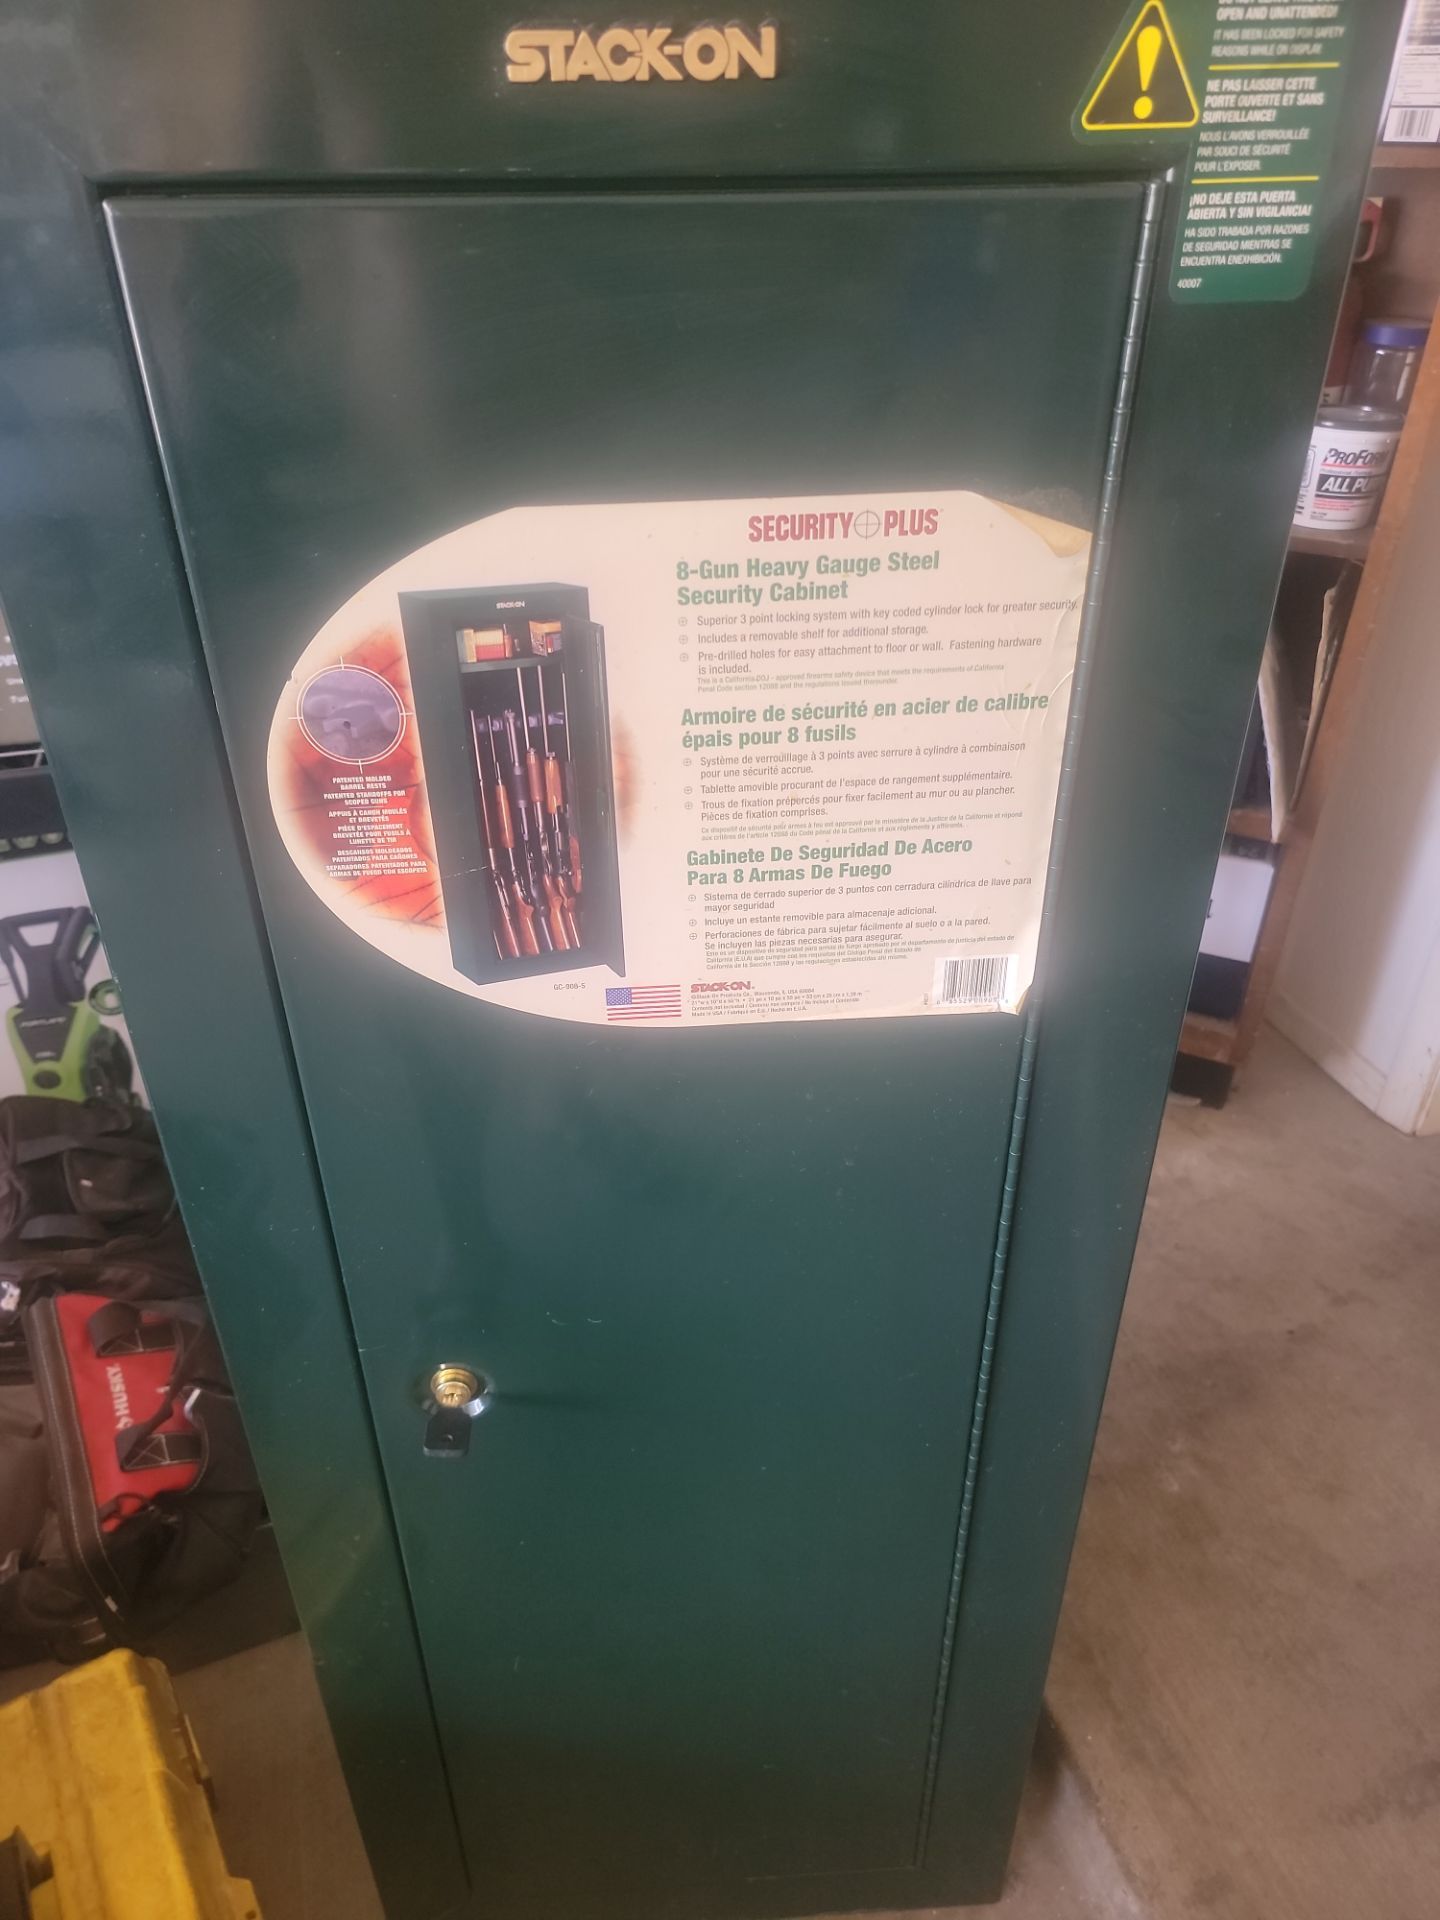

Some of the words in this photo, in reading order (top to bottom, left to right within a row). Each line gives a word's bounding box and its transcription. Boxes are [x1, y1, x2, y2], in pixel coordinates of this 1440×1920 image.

[1216, 7, 1245, 21] OPEN
[1245, 6, 1268, 20] AND
[505, 26, 776, 82] STACK-ON
[1207, 79, 1220, 92] NE
[1222, 78, 1241, 91] PAS
[1243, 78, 1284, 91] LAISSER
[1285, 76, 1317, 90] CETTE
[1204, 95, 1236, 108] PORTE
[1238, 94, 1281, 107] OUVERTE
[1282, 93, 1296, 106] ET
[1296, 92, 1324, 105] SANS
[1202, 109, 1276, 123] SURVEILLANCE!
[1208, 192, 1233, 205] DEJE
[1234, 191, 1257, 204] ESTA
[1260, 190, 1296, 203] PUERTA
[1187, 207, 1226, 220] ABIERTA
[1230, 207, 1236, 218] Y
[1237, 206, 1254, 218] SIN
[1256, 204, 1312, 217] VIGILANCIA!
[1184, 227, 1195, 237] HA
[1197, 227, 1216, 237] SIDO
[1218, 225, 1253, 236] TRABADA
[1255, 225, 1271, 235] POR
[1273, 224, 1310, 234] RAZONES
[1182, 242, 1193, 252] DE
[1195, 241, 1239, 252] SEGURIDAD
[1240, 239, 1280, 250] MIENTRAS
[1281, 239, 1292, 249] SE
[1181, 255, 1225, 266] ENCUENTRA
[1177, 278, 1202, 288] 40007
[1321, 477, 1350, 493] ALL
[748, 512, 854, 542] SECURITY
[883, 508, 938, 536] PLUS
[676, 558, 740, 581] 8-Gun
[746, 557, 809, 581] Heavy
[816, 554, 881, 577] Gauge
[888, 551, 940, 571] Steel
[677, 584, 762, 608] Security
[769, 580, 849, 603] Cabinet
[697, 615, 737, 627] Superior
[740, 615, 746, 624] 3
[749, 613, 773, 625] point
[776, 612, 810, 624] locking
[813, 611, 847, 622] system
[850, 609, 870, 619] with
[873, 608, 889, 619] key
[893, 607, 921, 617] coded
[924, 605, 961, 618] cylinder
[965, 604, 983, 614] lock
[987, 603, 999, 613] for
[1002, 602, 1036, 614] greater
[1039, 599, 1078, 611] security.
[697, 633, 737, 643] Includes
[740, 634, 746, 642] a
[749, 631, 798, 641] removable
[801, 628, 824, 639] shelf
[827, 628, 839, 638] for
[842, 626, 888, 637] additional
[891, 624, 928, 637] storage.
[698, 650, 748, 662] Pre-drilled
[750, 649, 775, 659] holes
[778, 648, 790, 658] for
[794, 648, 815, 658] easy
[818, 645, 871, 657] attachment
[874, 645, 882, 653] to
[886, 642, 906, 653] floor
[910, 643, 919, 652] or
[922, 641, 944, 651] wall.
[949, 639, 995, 651] Fastening
[998, 636, 1042, 648] hardware
[699, 665, 707, 674] is
[709, 664, 751, 674] included.
[681, 706, 756, 726] Armoire
[763, 705, 785, 722] de
[792, 700, 867, 721] sécurité
[874, 702, 896, 716] en
[903, 697, 950, 715] acier
[956, 696, 978, 713] de
[984, 692, 1049, 711] calibre
[682, 730, 732, 752] épais
[739, 731, 782, 749] pour
[788, 726, 799, 743] 8
[805, 724, 856, 742] fusils
[701, 783, 735, 794] Tablette
[738, 780, 778, 792] amovible
[781, 779, 823, 792] procurant
[826, 779, 837, 788] de
[839, 776, 876, 788] l'espace
[879, 775, 890, 785] de
[892, 774, 940, 785] rangement
[943, 770, 1013, 783] supplémentaire.
[701, 809, 730, 821] Pièces
[732, 810, 743, 820] de
[746, 807, 778, 819] fixation
[780, 807, 828, 819] comprises.
[687, 849, 765, 866] Gabinete
[771, 847, 793, 862] De
[799, 841, 889, 862] Seguridad
[895, 840, 916, 855] De
[921, 839, 973, 854] Acero
[688, 871, 727, 885] Para
[733, 868, 744, 883] 8
[749, 867, 805, 882] Armas
[811, 864, 833, 879] De
[839, 863, 892, 880] Fuego
[704, 891, 738, 901] Sistema
[741, 890, 751, 899] de
[754, 889, 786, 899] cerrado
[788, 887, 823, 898] superior
[825, 886, 835, 895] de
[838, 885, 844, 894] 3
[846, 884, 875, 895] puntos
[877, 883, 892, 892] con
[895, 881, 935, 891] cerradura
[978, 878, 988, 887] de
[991, 876, 1011, 886] llave
[1013, 876, 1032, 886] para
[704, 902, 730, 912] mayor
[733, 901, 775, 911] seguridad
[705, 917, 734, 928] Incluye
[737, 916, 747, 924] un
[750, 914, 780, 924] estante
[783, 911, 824, 922] removible
[826, 911, 845, 921] para
[847, 907, 895, 919] almacenaje
[897, 906, 937, 916] adicional.
[705, 941, 715, 950] Se
[718, 940, 753, 951] incluyen
[755, 939, 767, 947] las
[769, 938, 795, 948] piezas
[798, 935, 842, 945] necesarias
[845, 934, 863, 944] para
[865, 932, 903, 942] asegurar.
[691, 981, 750, 993] STACK-ON
